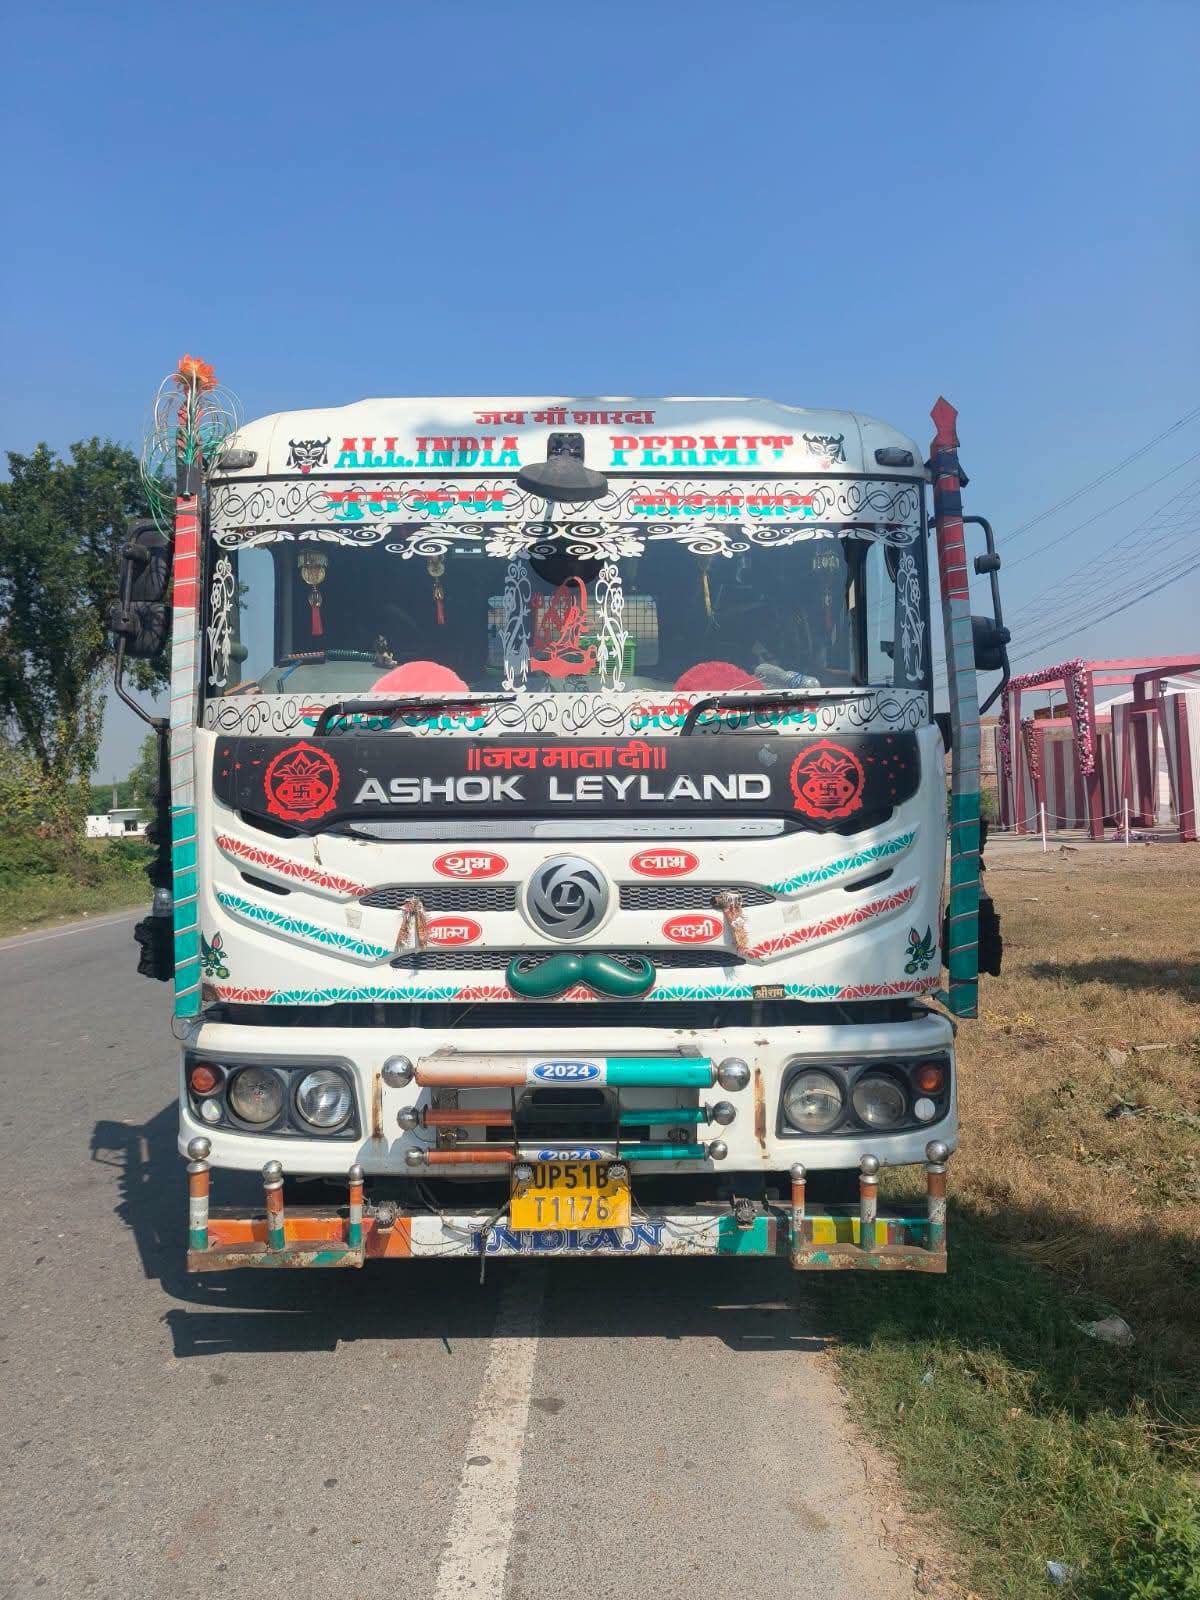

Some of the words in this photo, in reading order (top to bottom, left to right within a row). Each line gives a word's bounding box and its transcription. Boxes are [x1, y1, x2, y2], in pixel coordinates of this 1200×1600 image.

[473, 411, 528, 425] जय
[571, 411, 656, 425] शारदा
[609, 435, 794, 467] PERMIT
[542, 746, 615, 769] माता
[353, 775, 526, 805] ASHOK
[550, 774, 771, 803] LEYLAND
[445, 857, 492, 875] शुभ
[639, 855, 688, 869] लाभ
[542, 1065, 591, 1077] 2024
[548, 1151, 591, 1161] 2024
[534, 1164, 609, 1189] UP51B
[535, 1196, 609, 1222] T1176
[467, 1221, 666, 1253] INDIAN
